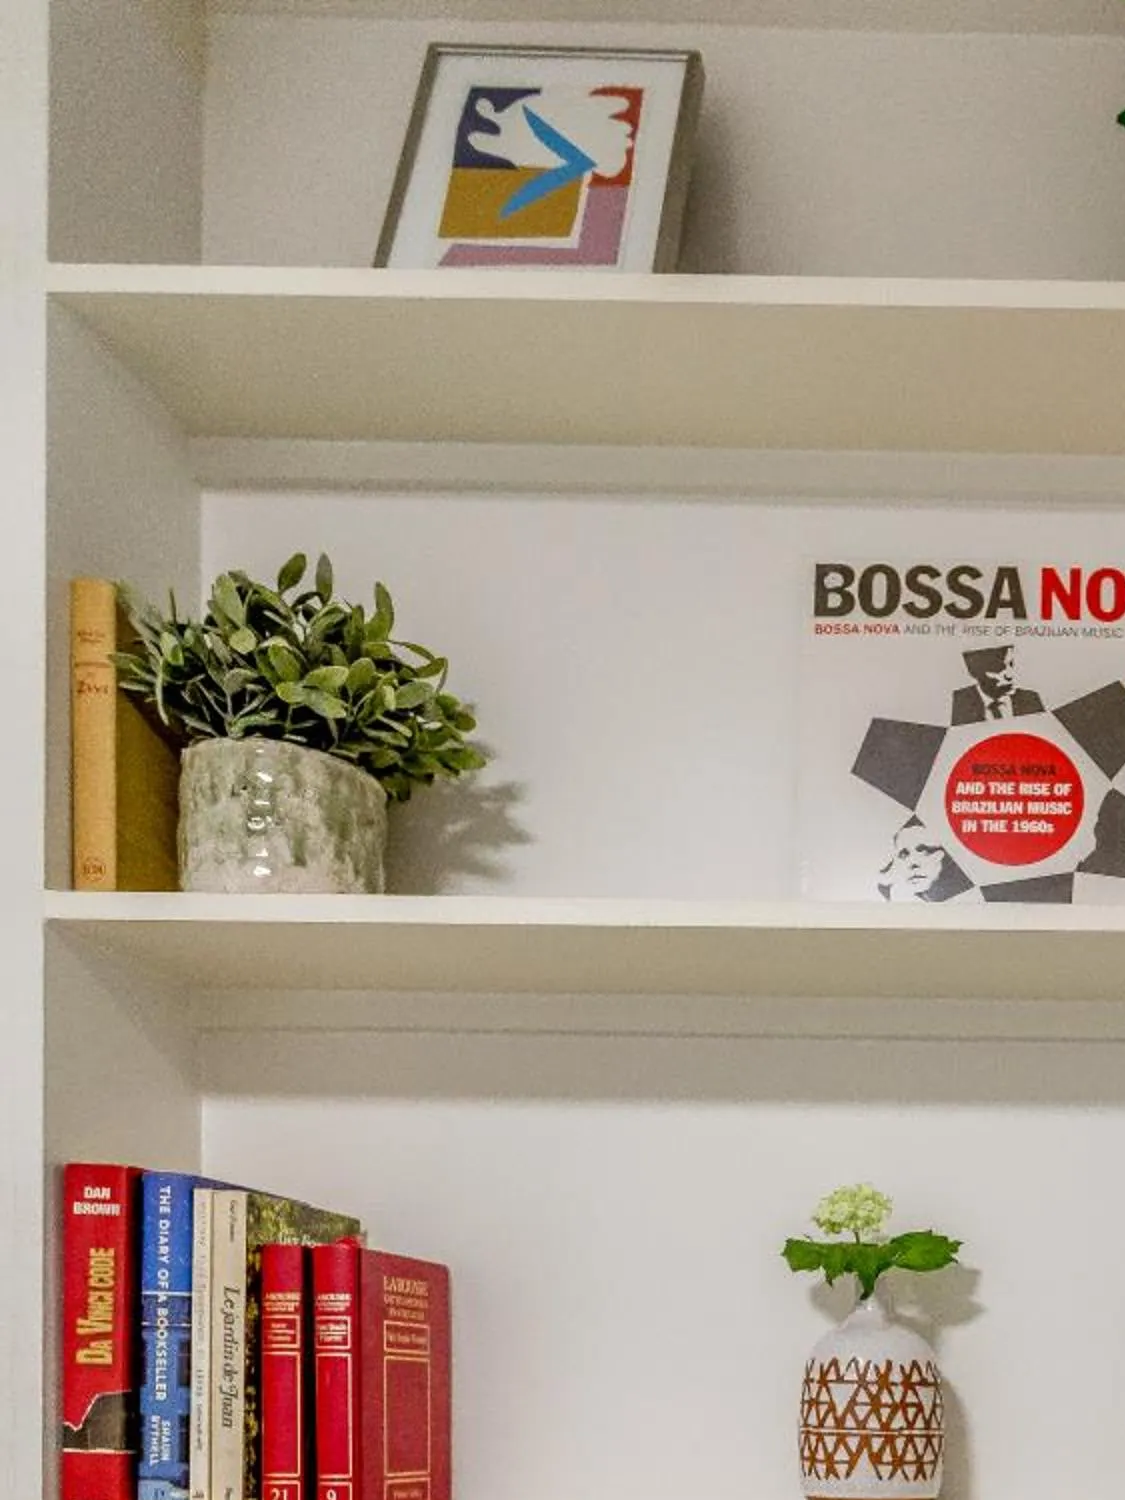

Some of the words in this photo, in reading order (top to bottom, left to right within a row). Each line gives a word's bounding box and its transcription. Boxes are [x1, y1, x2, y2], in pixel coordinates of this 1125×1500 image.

[814, 563, 1027, 619] BOSSA
[815, 624, 859, 635] BOSSA
[863, 624, 900, 635] NOVA
[903, 625, 930, 635] AND
[935, 625, 956, 637] THE
[963, 625, 990, 637] RISE
[995, 626, 1011, 637] OF
[1015, 625, 1077, 638] BRAZILIAN
[1081, 627, 1123, 639] MUSIC
[972, 763, 1014, 775] BOSSA
[1020, 764, 1056, 775] NOVA
[956, 781, 985, 795] AND
[988, 782, 1015, 795] THE
[1019, 783, 1051, 796] RISE
[1054, 783, 1073, 796] OF
[951, 801, 1024, 814] BRAZILIAN
[1027, 801, 1073, 815] MUSIC
[962, 819, 977, 832] IN
[980, 819, 1008, 833] THE
[1011, 819, 1055, 833] 1960s
[83, 1186, 111, 1200] DAN
[158, 1185, 171, 1214] THE
[73, 1202, 121, 1216] BROWN
[157, 1219, 170, 1265] DIARY
[157, 1269, 169, 1289] OF
[157, 1291, 168, 1303] A
[223, 1285, 241, 1307] Le
[220, 1308, 240, 1364] jardin
[155, 1307, 169, 1401] BOOKSELLER
[222, 1365, 239, 1382] de
